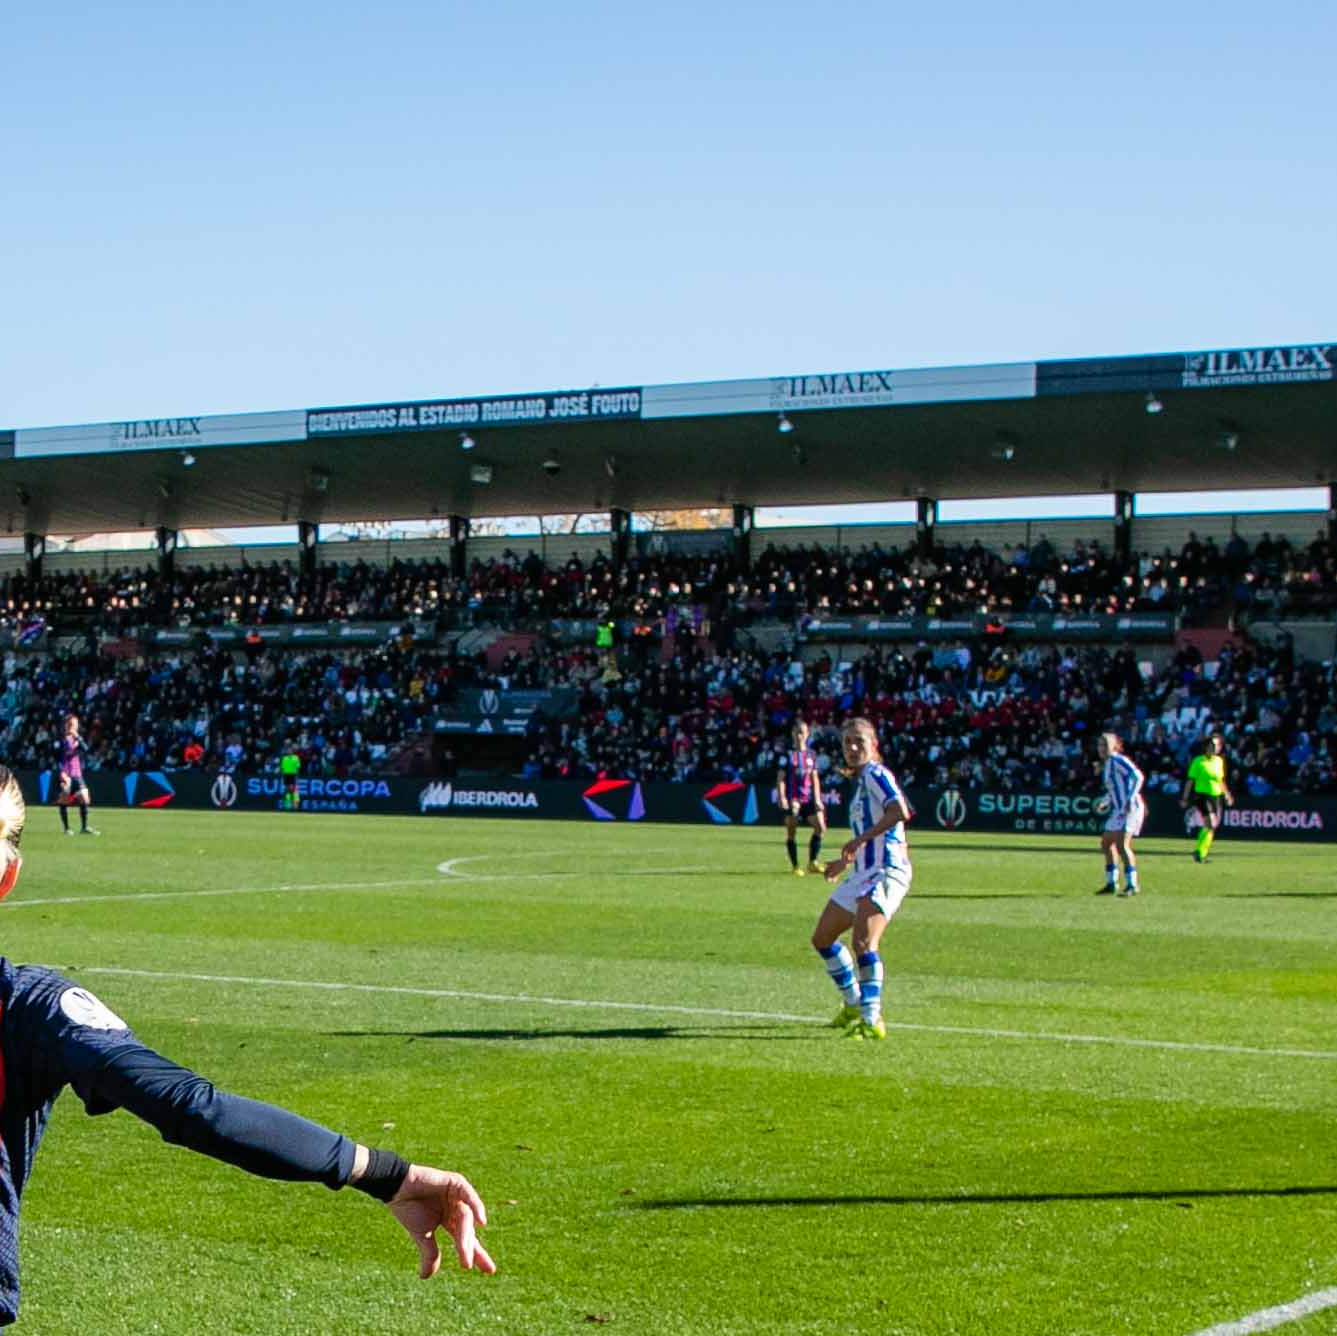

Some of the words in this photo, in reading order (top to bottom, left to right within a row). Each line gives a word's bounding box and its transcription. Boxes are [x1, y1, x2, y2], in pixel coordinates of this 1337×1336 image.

[308, 409, 396, 433] BIENVENIDOS
[398, 407, 417, 427] AL
[419, 403, 479, 426] ESTADIO
[481, 399, 545, 422] ROMANO
[549, 392, 589, 417] JOSÉ
[591, 392, 640, 414] FOUTO
[453, 790, 538, 808] IBERDROLA
[1014, 818, 1036, 830] DE
[1223, 809, 1323, 830] IBERDROLA
